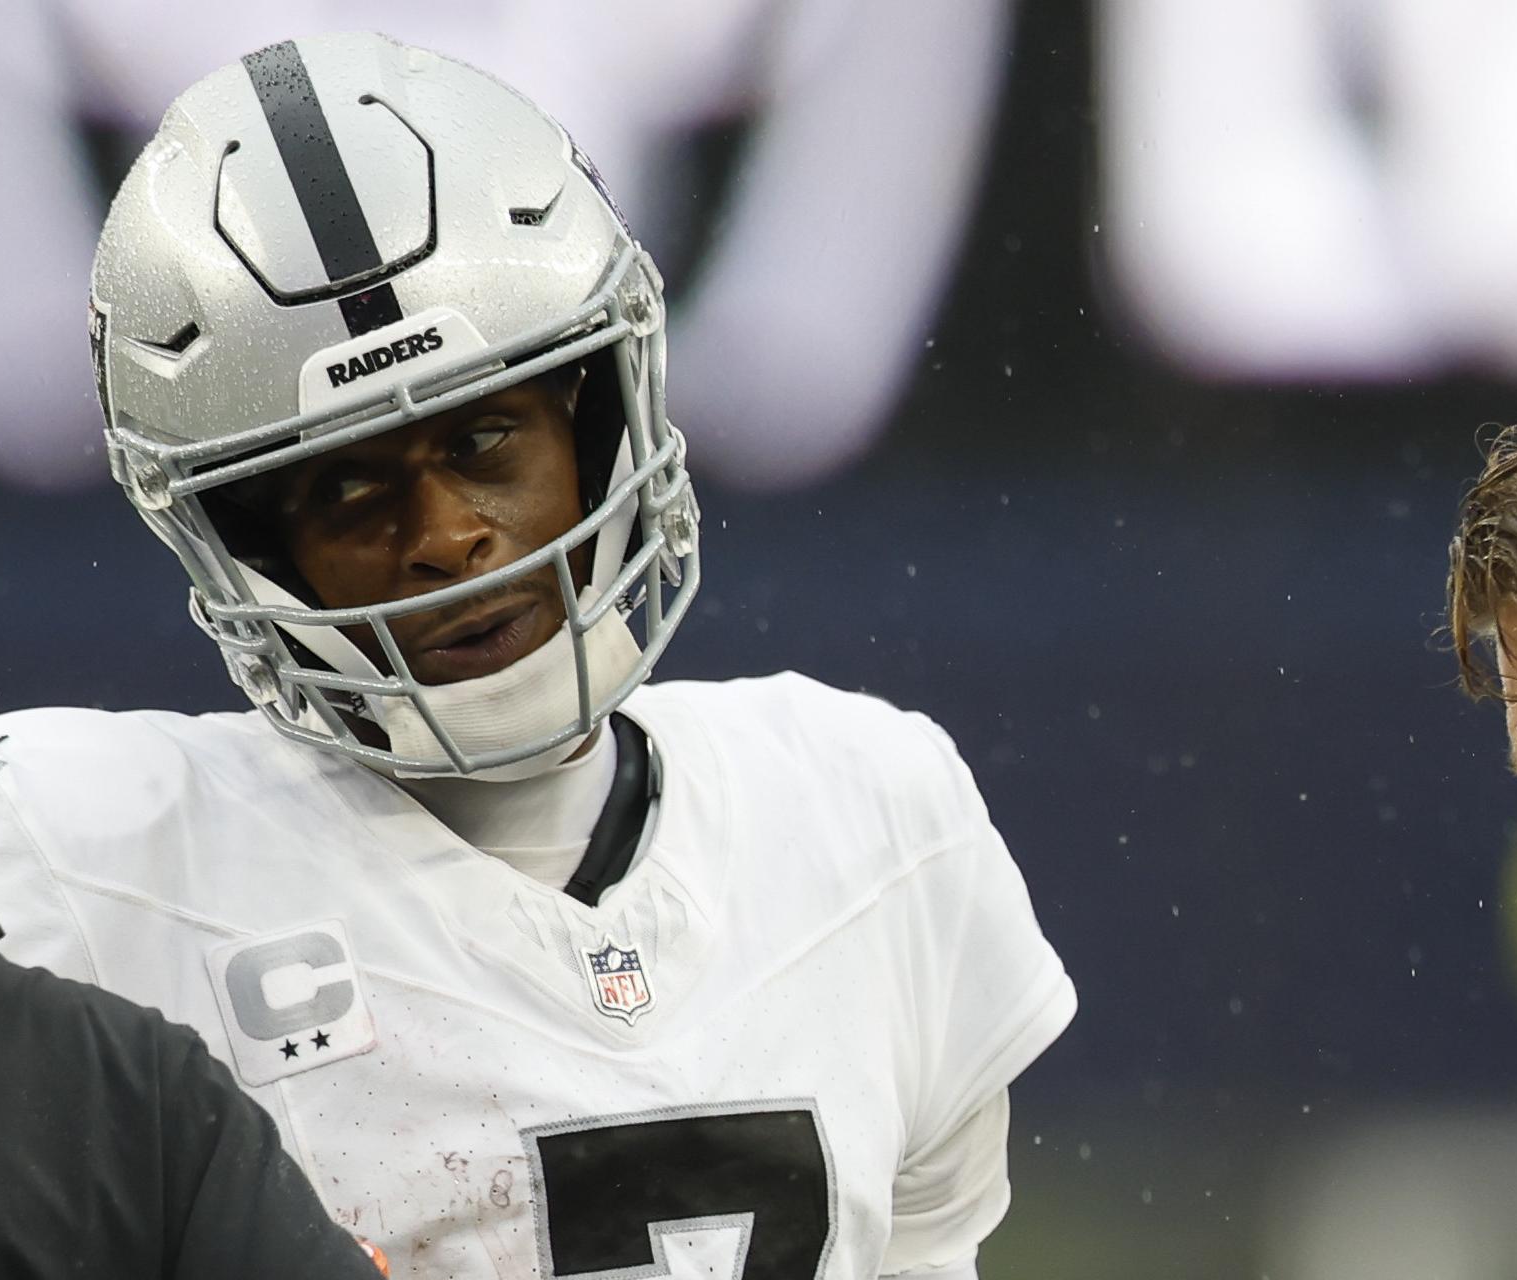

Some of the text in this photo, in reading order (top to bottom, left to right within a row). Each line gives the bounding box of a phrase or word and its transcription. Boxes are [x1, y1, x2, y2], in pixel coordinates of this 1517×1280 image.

[326, 327, 443, 388] RAIDERS
[225, 931, 354, 1041] C
[599, 974, 645, 1007] NFL
